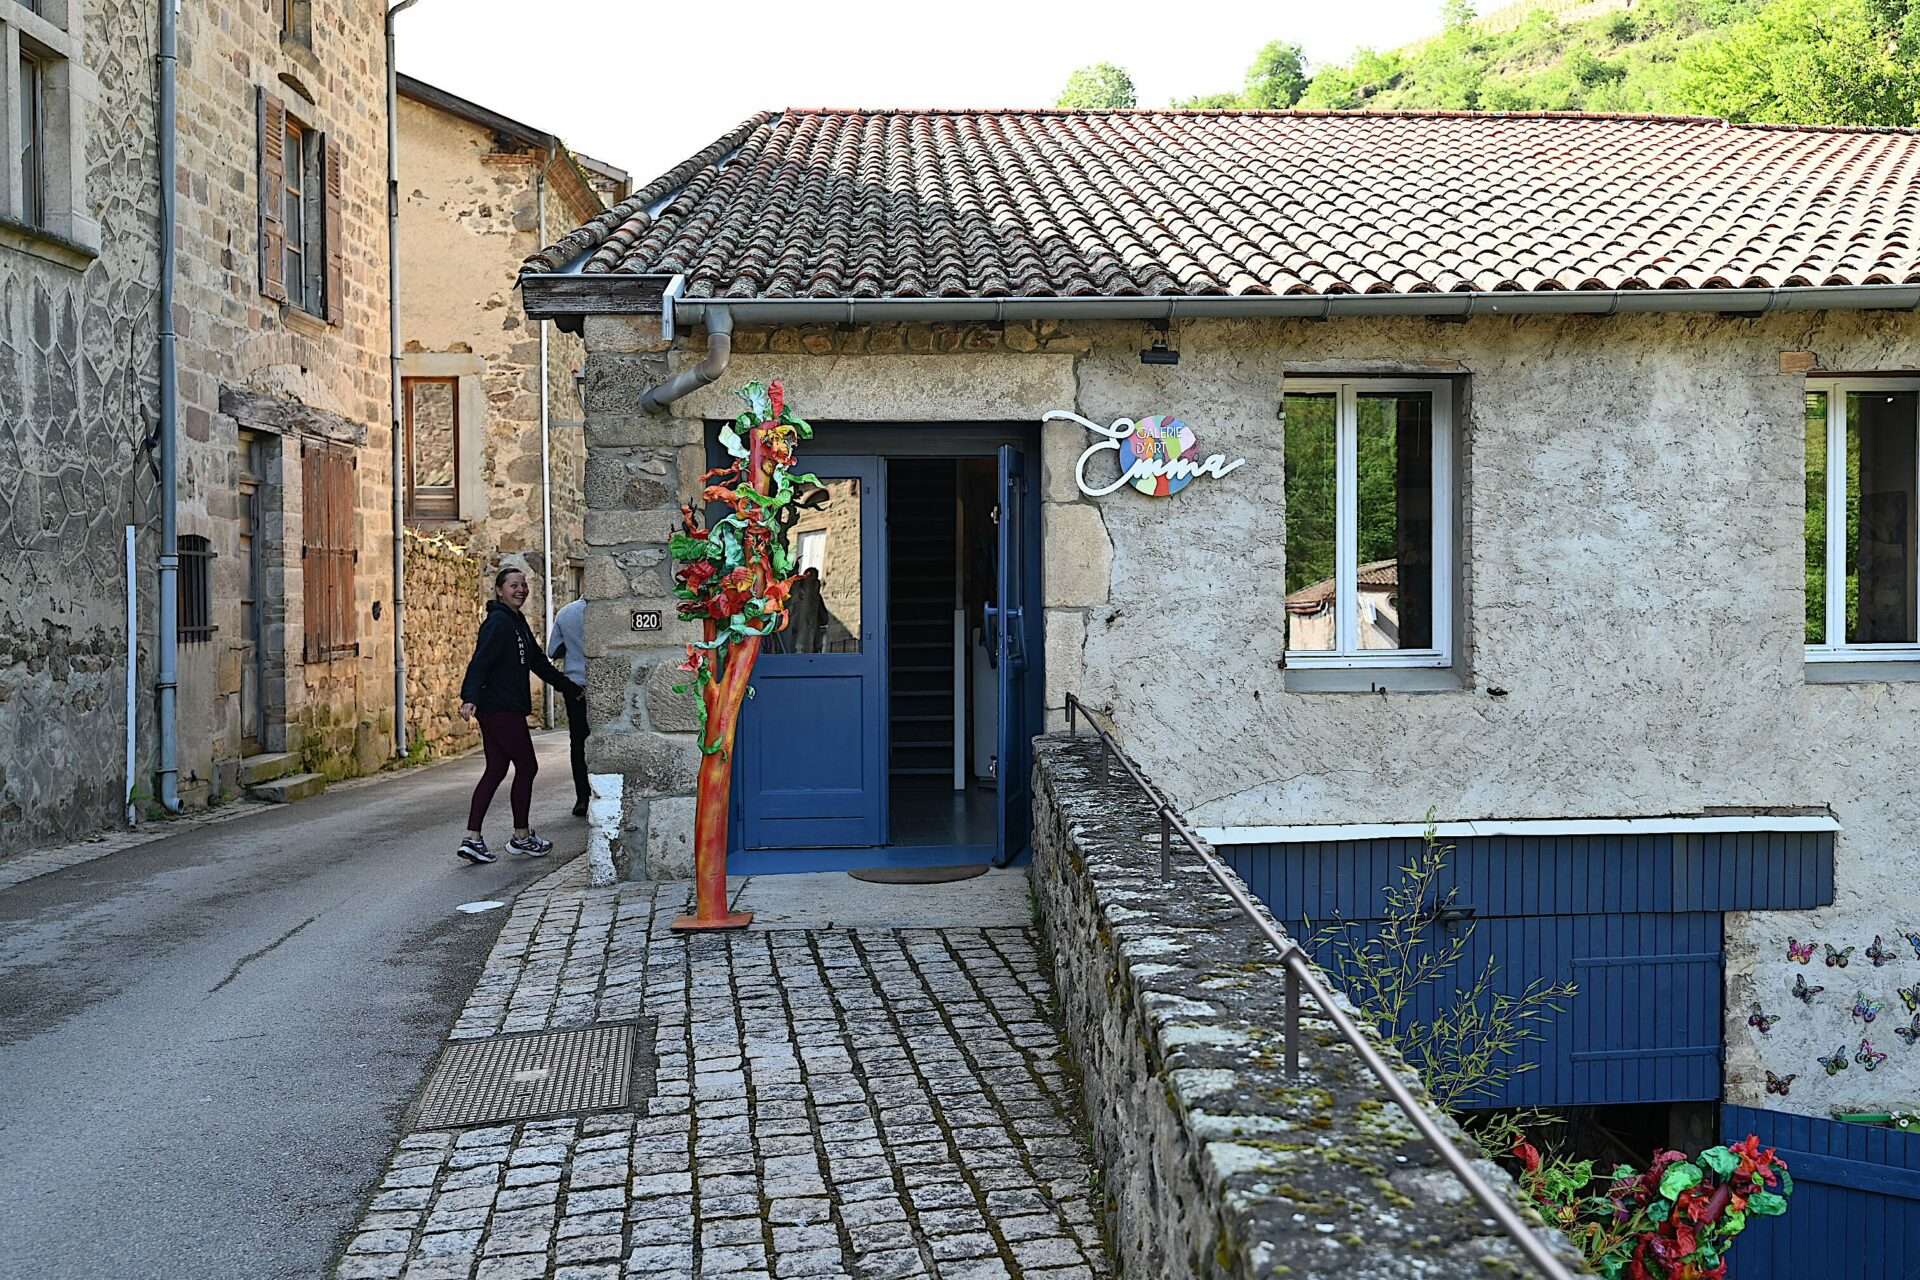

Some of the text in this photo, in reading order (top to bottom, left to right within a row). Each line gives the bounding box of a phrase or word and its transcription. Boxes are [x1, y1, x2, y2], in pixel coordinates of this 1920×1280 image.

[1136, 426, 1182, 439] GALERIE
[1042, 410, 1246, 497] Emma
[635, 614, 658, 628] 820
